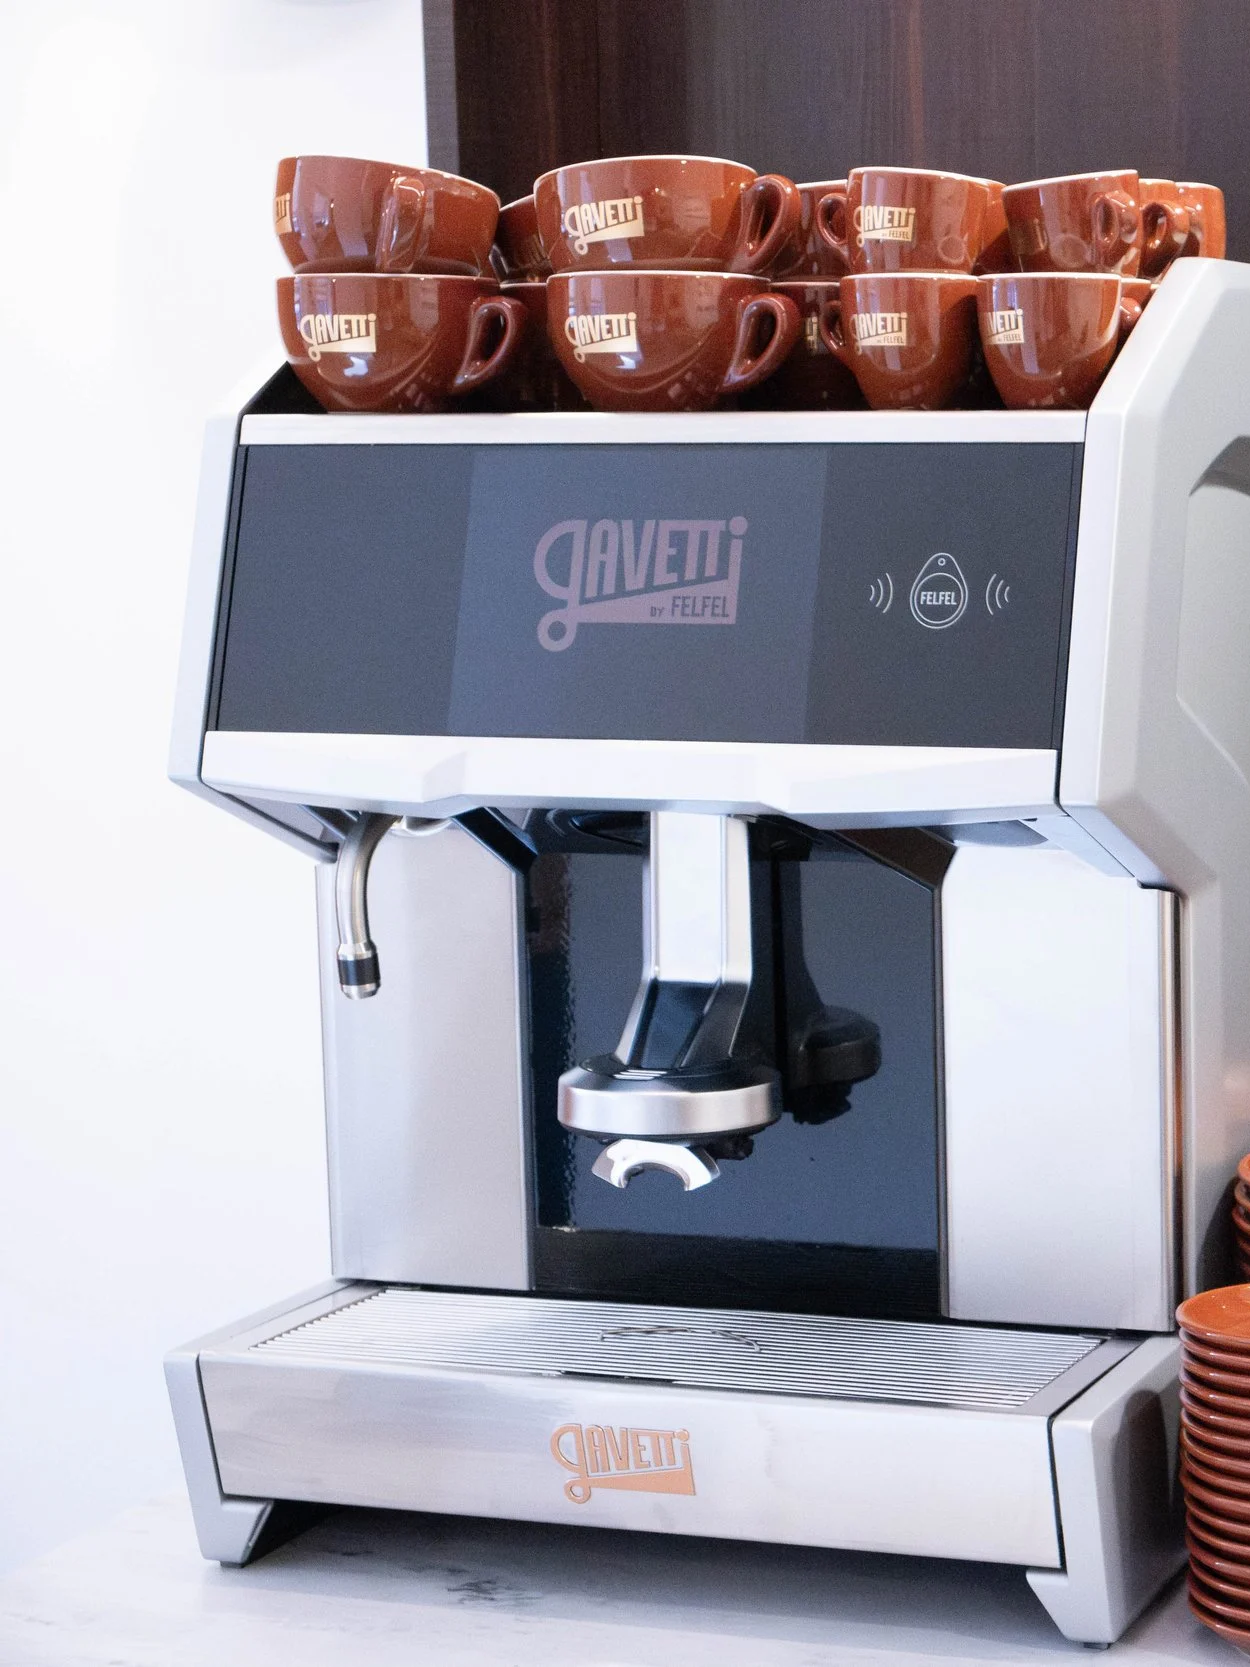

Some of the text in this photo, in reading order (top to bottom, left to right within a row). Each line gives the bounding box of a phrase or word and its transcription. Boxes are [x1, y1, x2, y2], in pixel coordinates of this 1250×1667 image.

[650, 595, 730, 619] BY FELFEL
[920, 590, 958, 606] FELFEL
